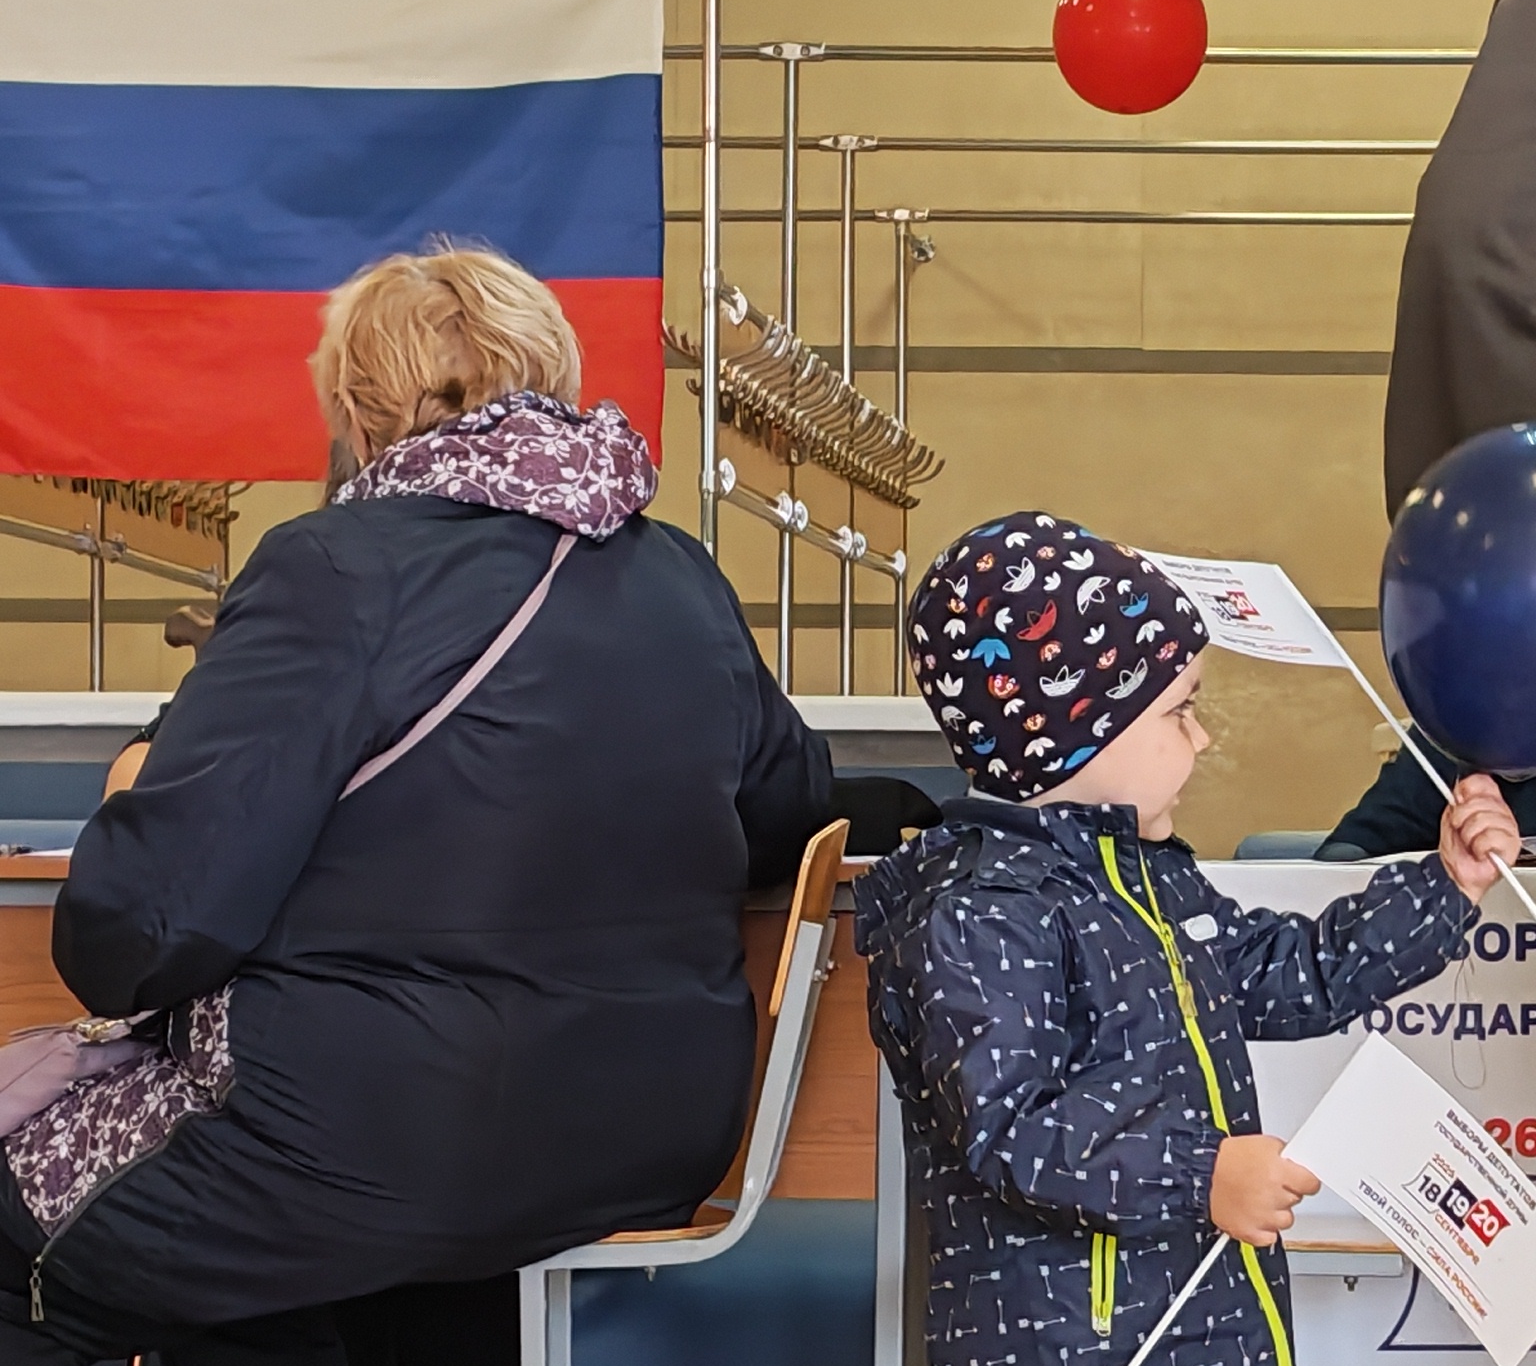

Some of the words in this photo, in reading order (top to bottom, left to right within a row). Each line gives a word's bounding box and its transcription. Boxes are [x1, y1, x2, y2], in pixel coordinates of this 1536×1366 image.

[1417, 1174, 1441, 1204] 18
[1447, 1187, 1470, 1217] 19
[1471, 1204, 1499, 1237] 20
